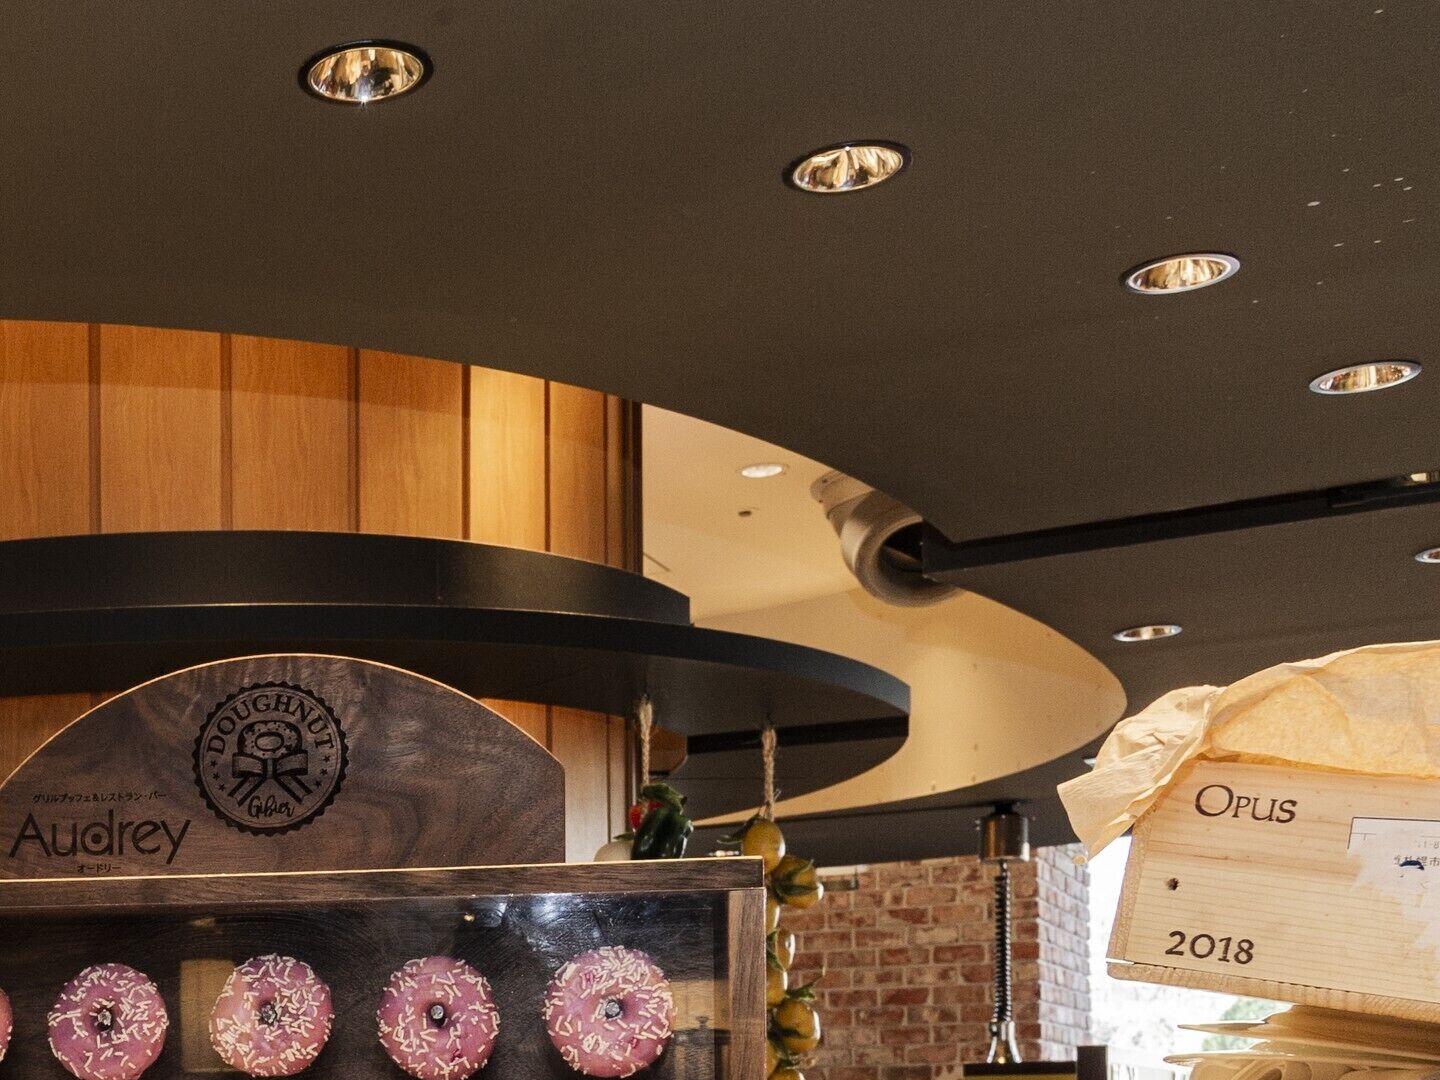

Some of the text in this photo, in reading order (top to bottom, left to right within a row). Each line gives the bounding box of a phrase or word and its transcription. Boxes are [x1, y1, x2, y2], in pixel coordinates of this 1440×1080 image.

[207, 693, 334, 755] DOUGHNUT
[248, 795, 295, 819] Gibier
[9, 809, 192, 865] Audrey
[77, 864, 122, 873] オードリー
[1165, 930, 1254, 965] 2018
